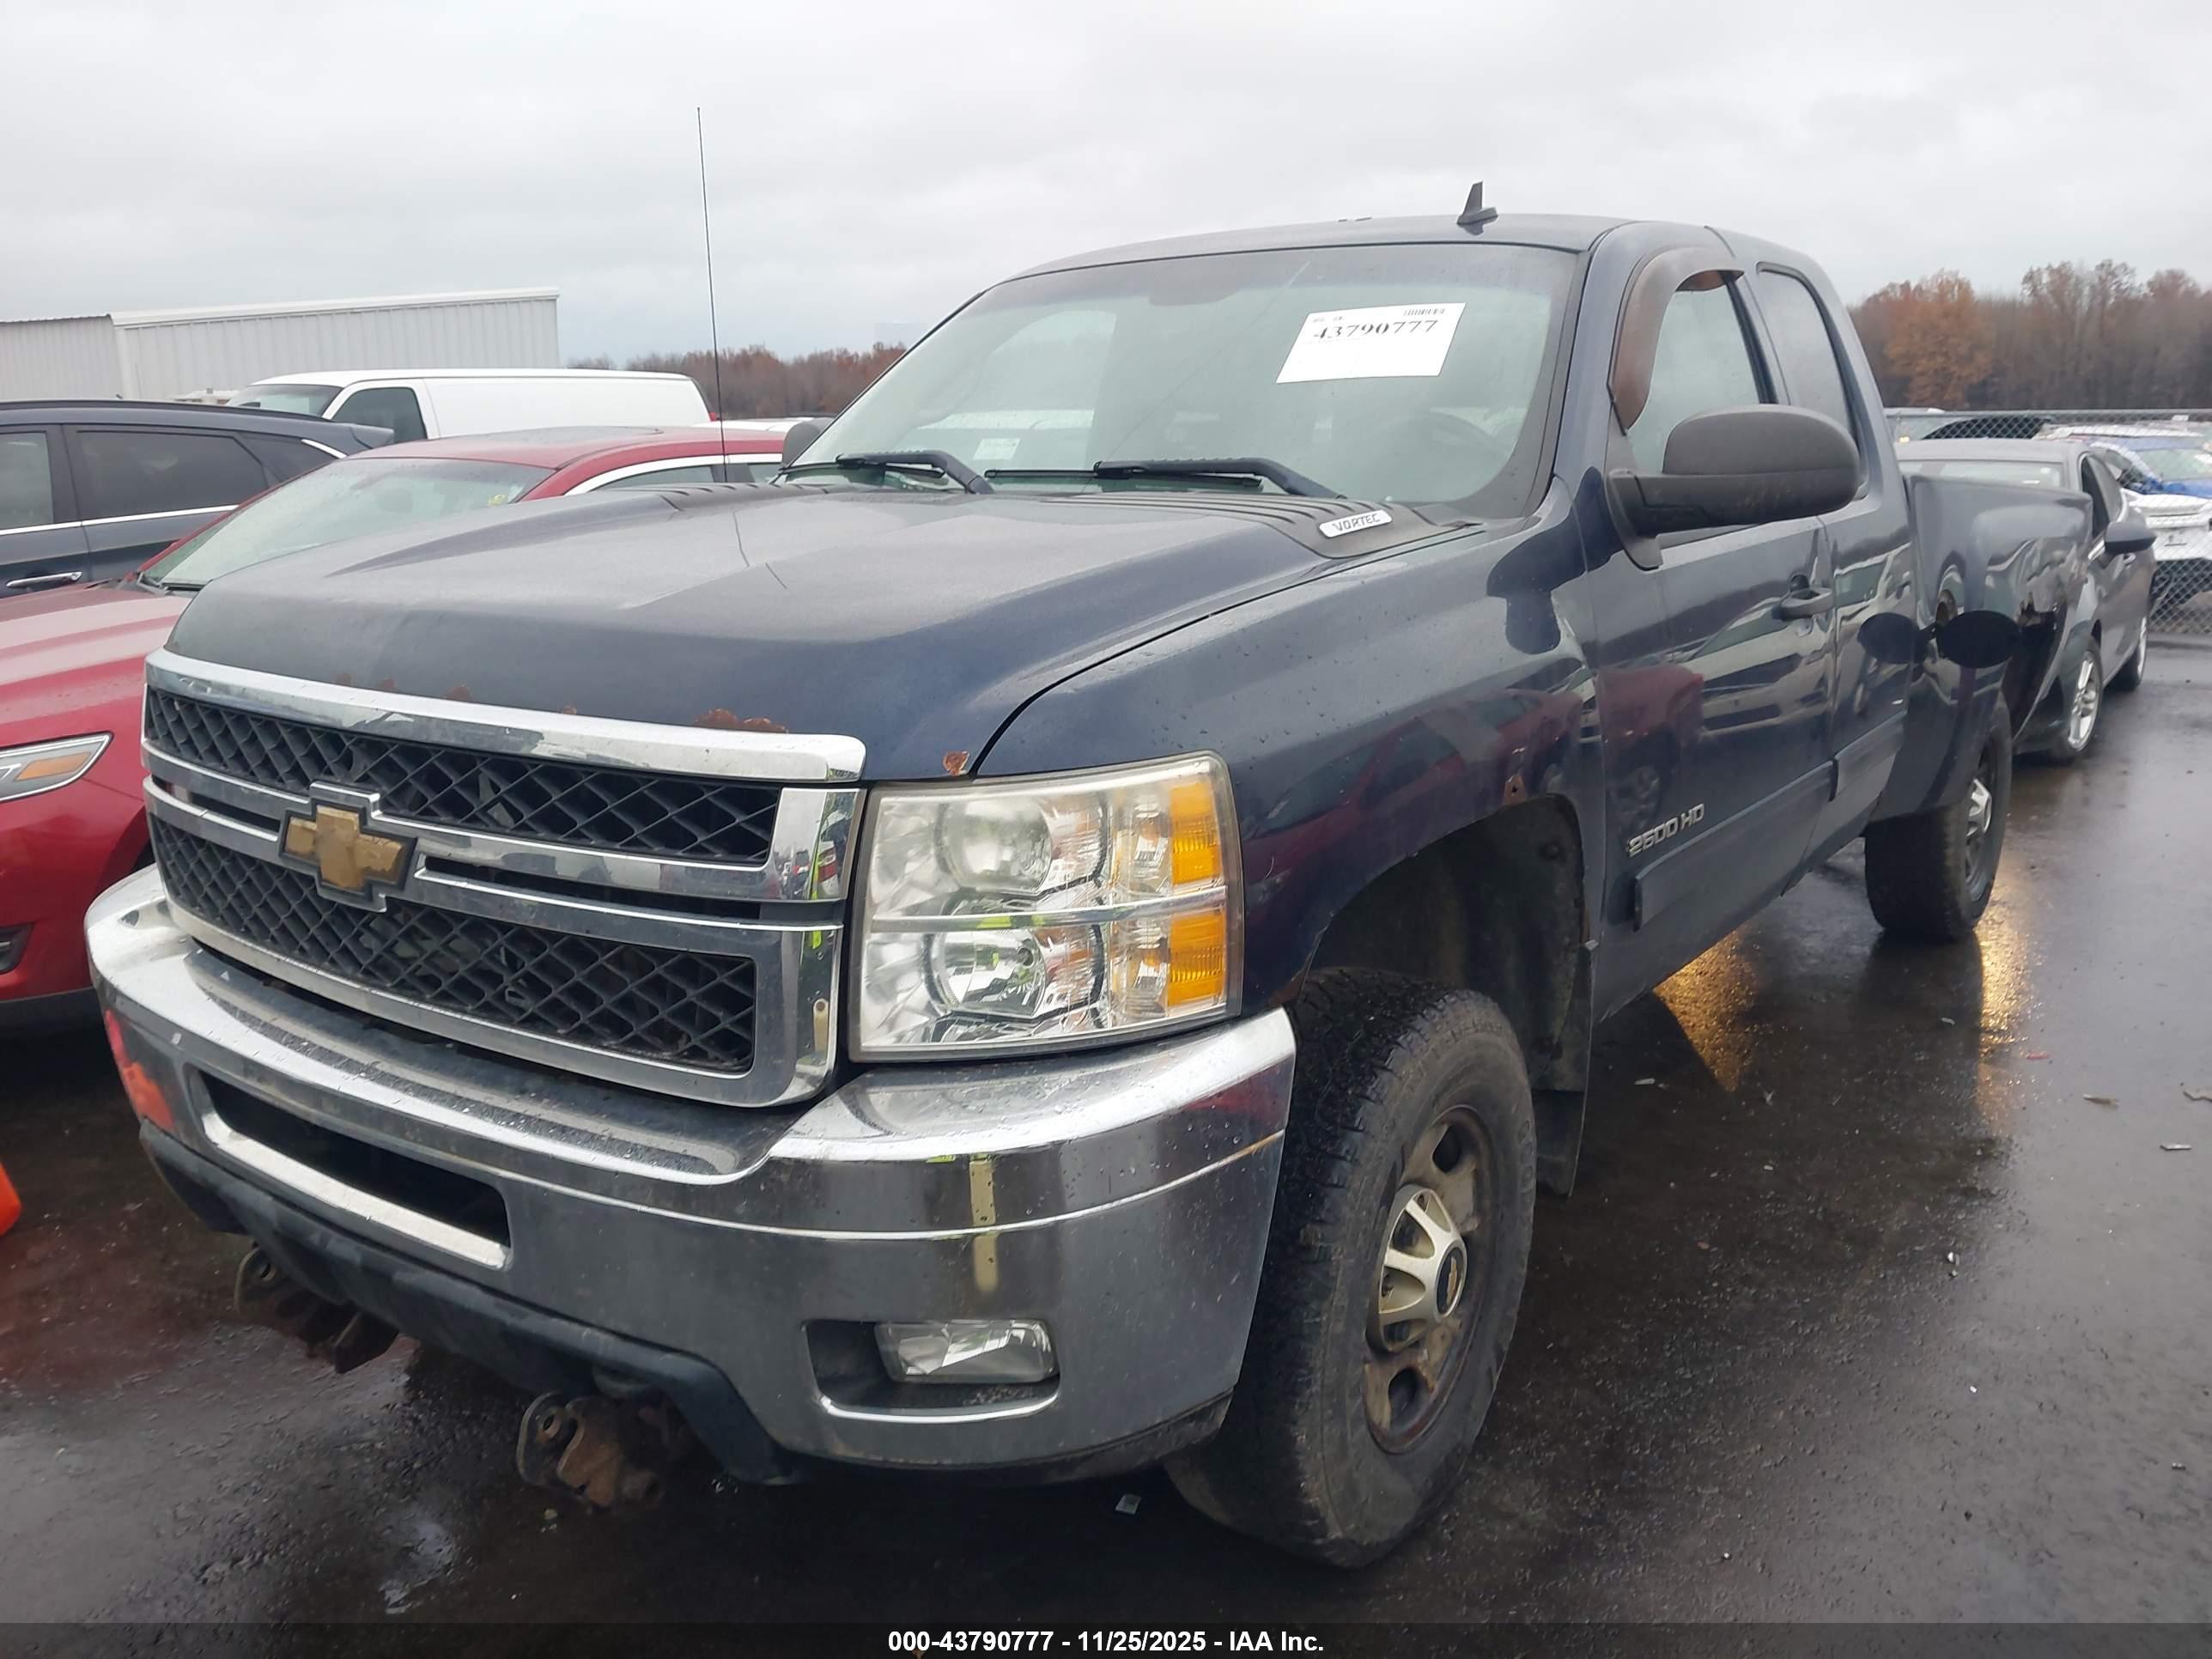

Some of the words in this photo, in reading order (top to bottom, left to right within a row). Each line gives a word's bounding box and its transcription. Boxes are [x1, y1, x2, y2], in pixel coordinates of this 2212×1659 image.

[1313, 319, 1438, 339] 43790777
[1332, 513, 1381, 531] VORTEC
[1628, 817, 1678, 858] 2500
[1680, 803, 1705, 830] HD
